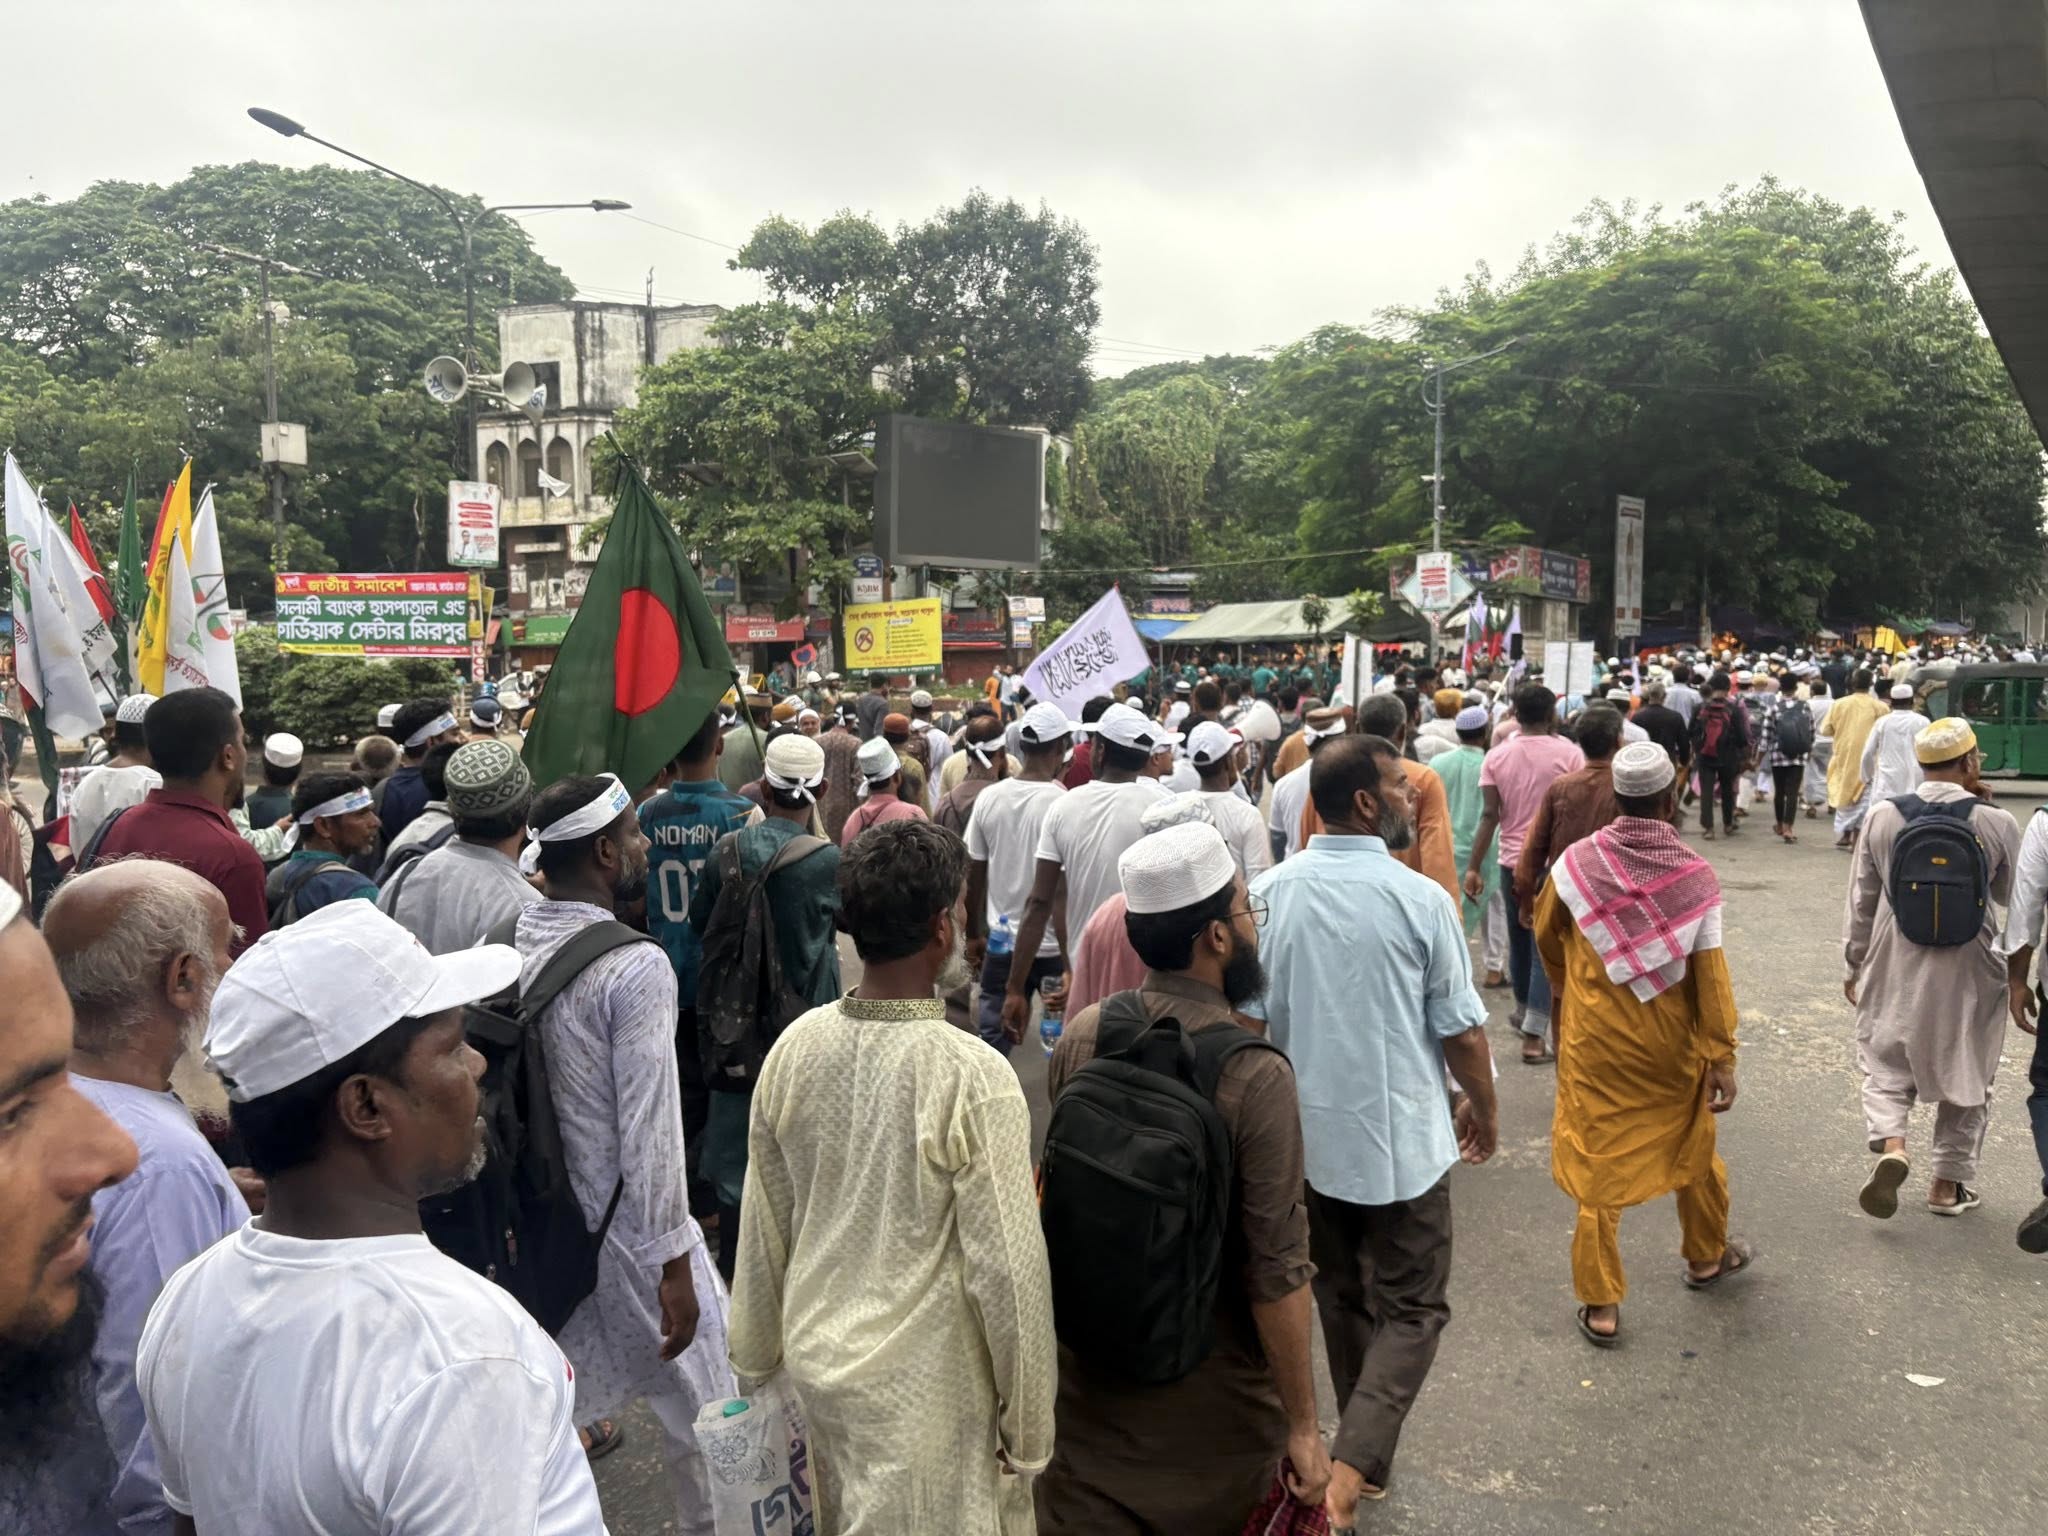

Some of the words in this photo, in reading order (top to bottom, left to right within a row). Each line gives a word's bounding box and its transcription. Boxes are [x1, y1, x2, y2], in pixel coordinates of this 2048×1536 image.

[307, 576, 350, 593] জাতীয়
[353, 580, 408, 593] সমাবেশ
[276, 595, 321, 616] সলামী
[325, 600, 366, 617] ব্যাংক
[369, 600, 438, 616] হাসপাতাল
[349, 617, 405, 641] সেন্টার
[409, 616, 467, 645] মিরপুর
[654, 823, 719, 846] NOMAN
